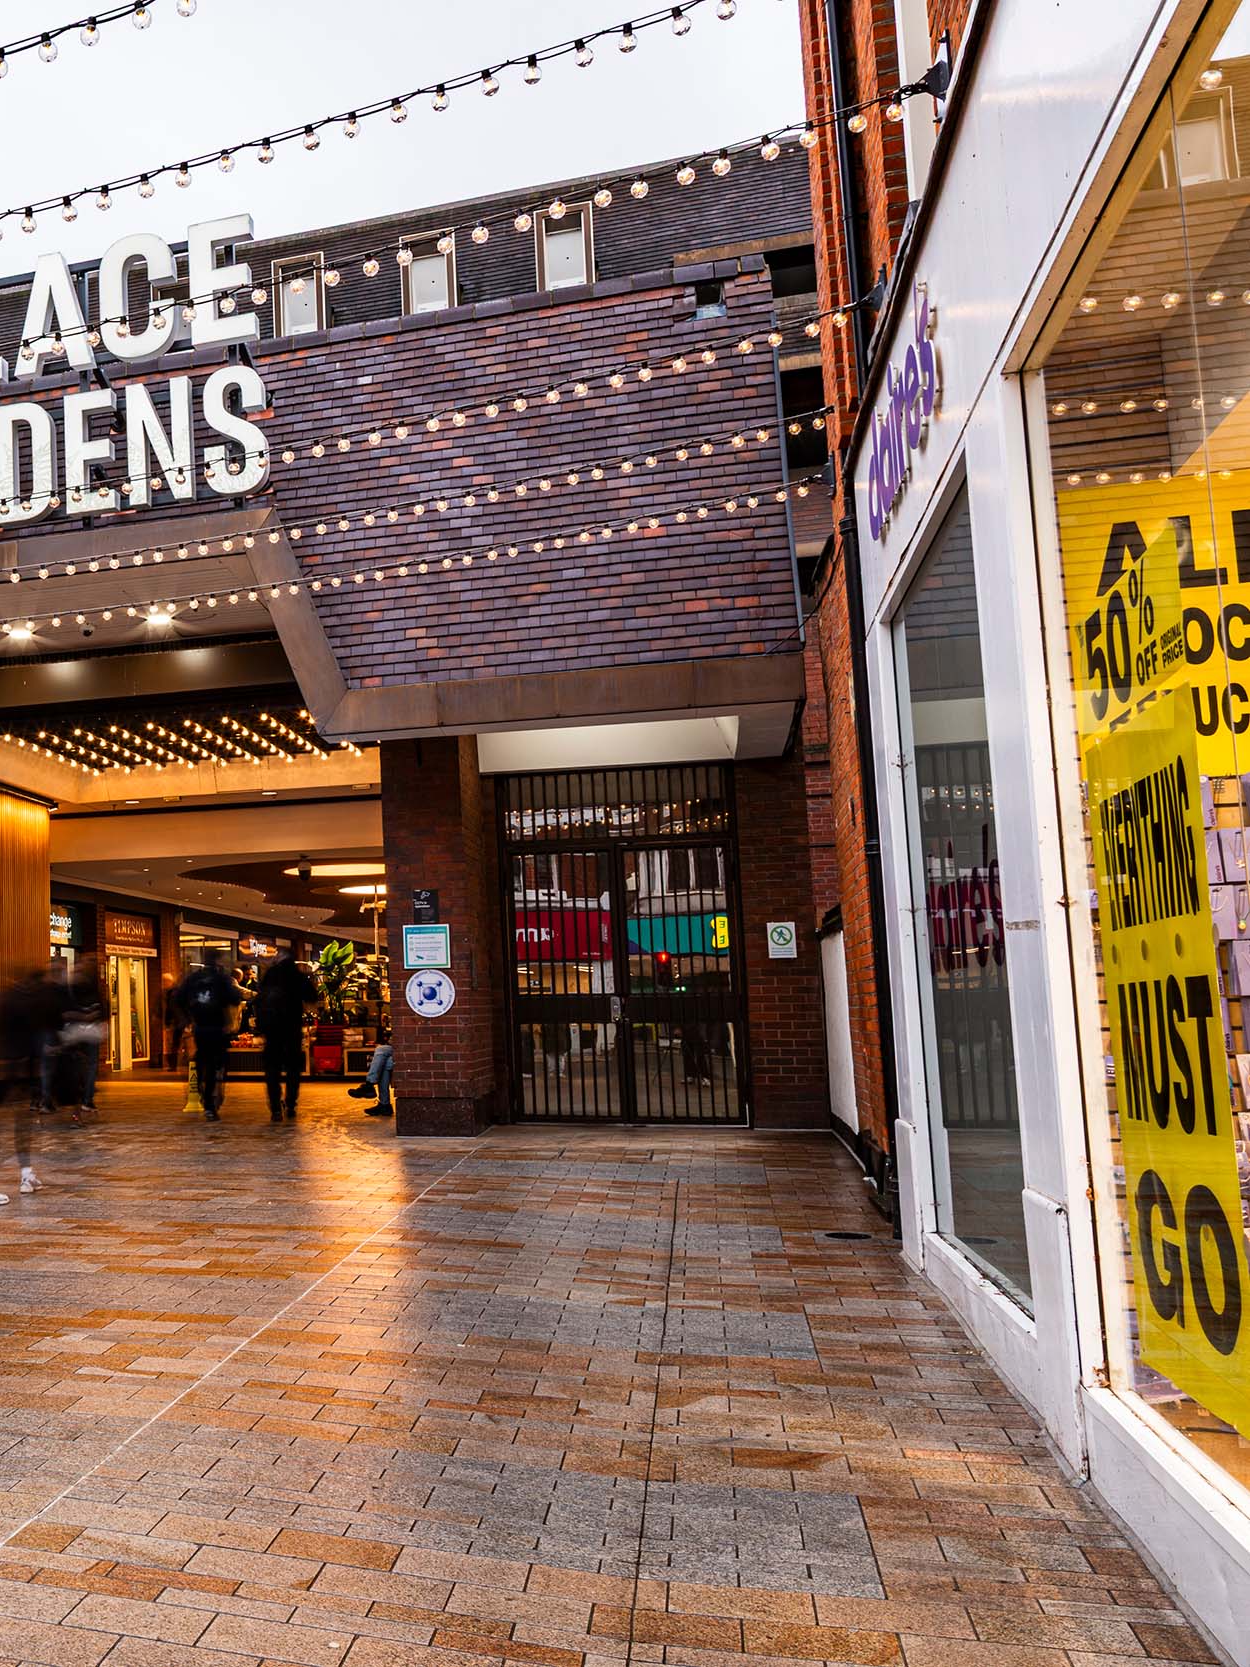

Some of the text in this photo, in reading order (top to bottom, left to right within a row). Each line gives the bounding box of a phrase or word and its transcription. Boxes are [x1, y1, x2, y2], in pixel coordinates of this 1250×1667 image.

[868, 281, 936, 542] claire's
[1084, 559, 1154, 721] 50%
[1136, 640, 1158, 686] OFF
[1160, 622, 1182, 651] ORIGINAL
[1162, 640, 1184, 669] PRICE
[1100, 754, 1201, 932] EVERYTHING
[113, 918, 146, 937] TIMPSON
[1117, 974, 1218, 1136] MUST
[1134, 1168, 1241, 1356] GO
